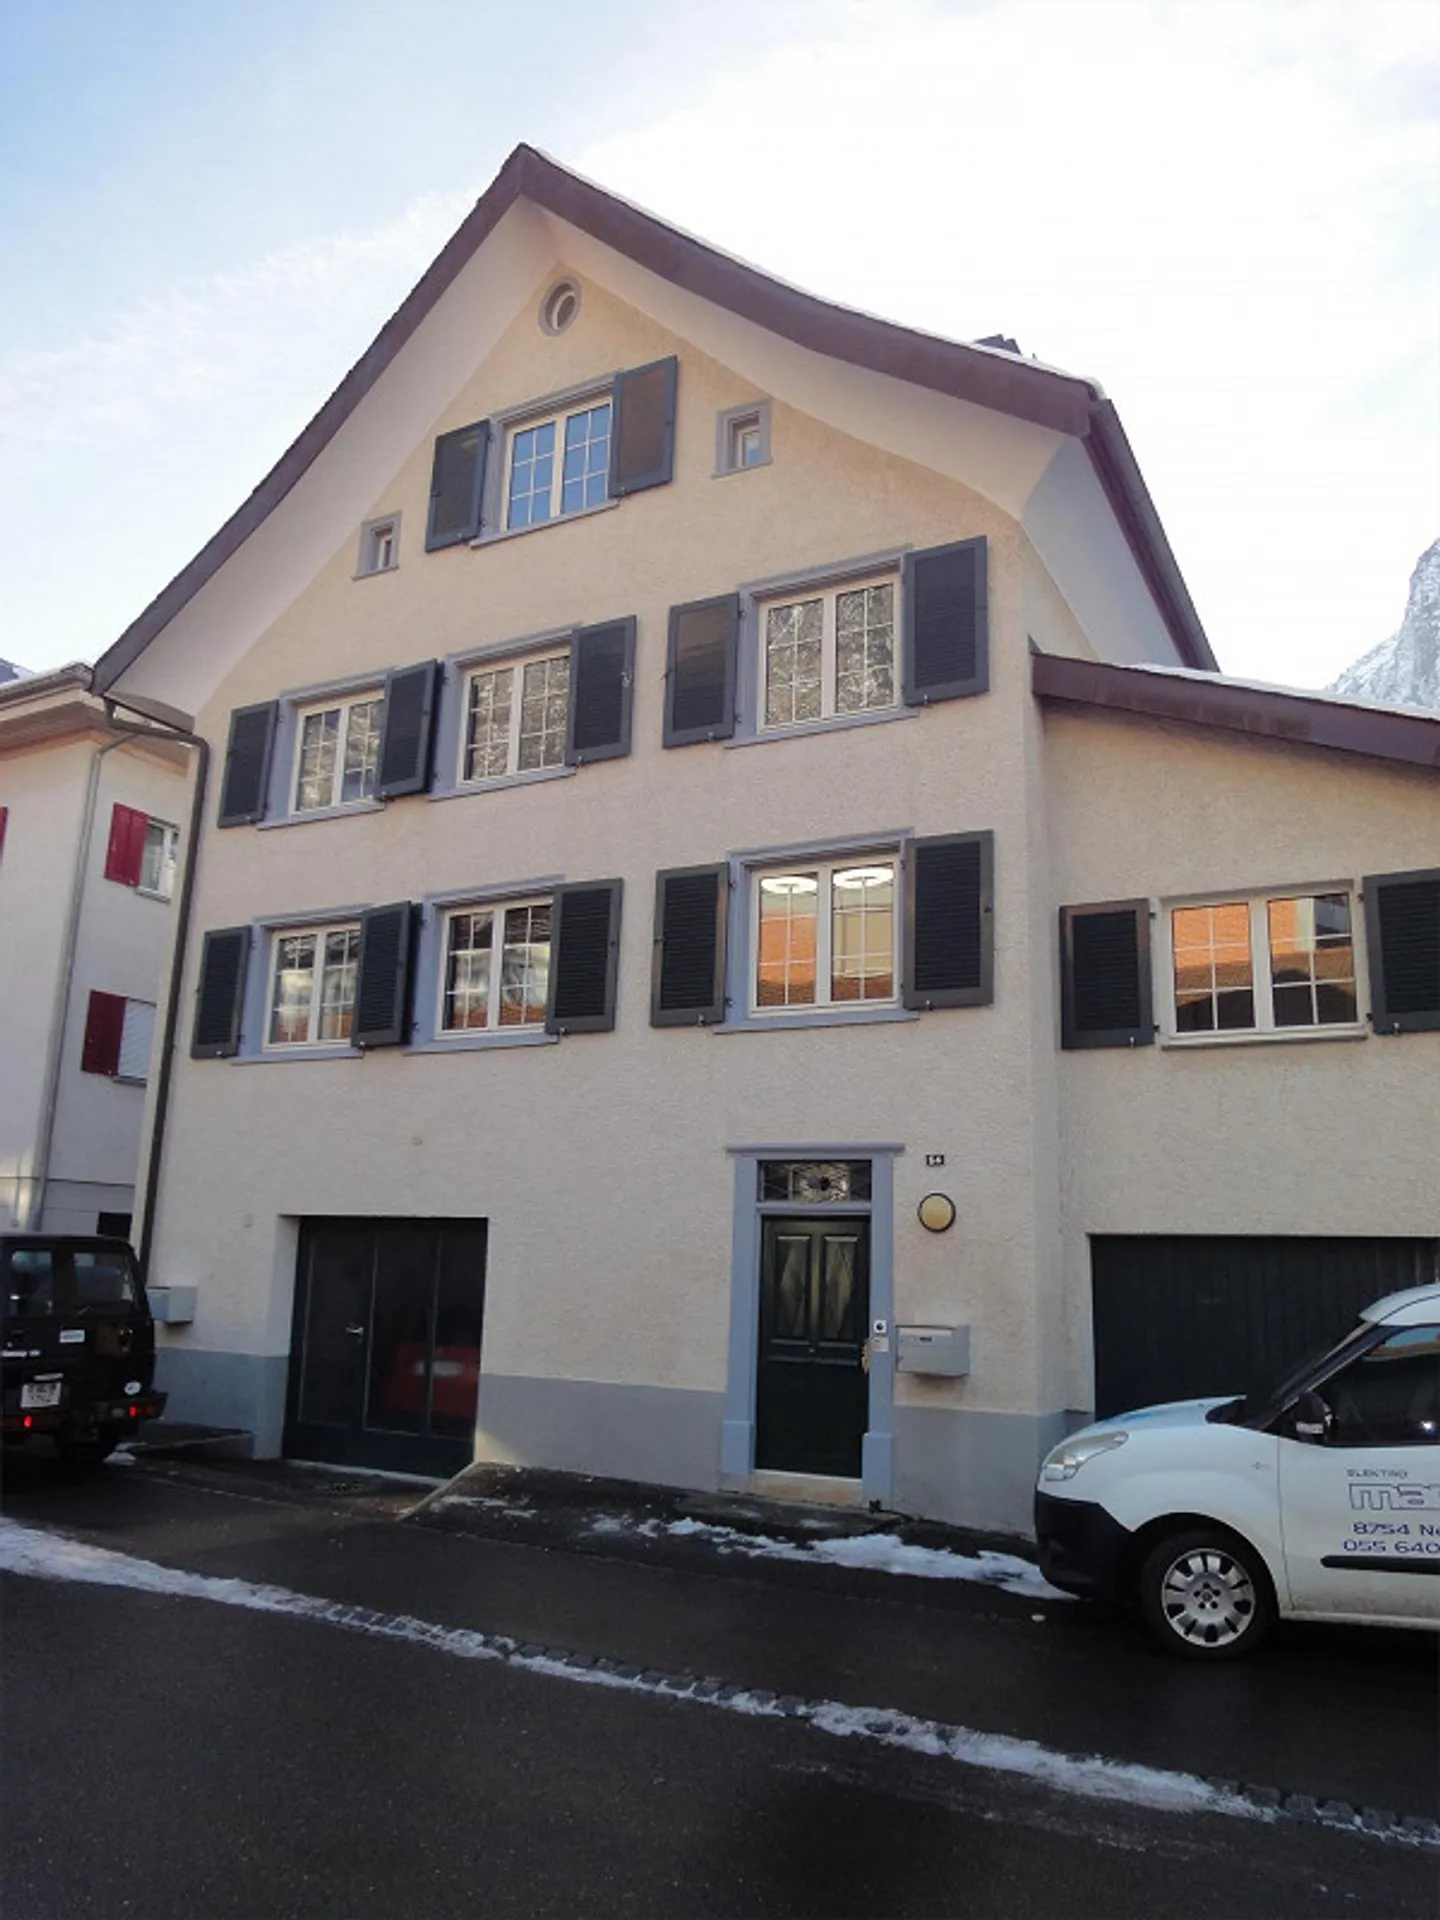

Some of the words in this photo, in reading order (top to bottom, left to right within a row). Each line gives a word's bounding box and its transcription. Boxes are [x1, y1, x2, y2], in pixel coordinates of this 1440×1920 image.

[1347, 1469, 1407, 1477] ELEKTRO
[1354, 1522, 1409, 1534] 8754
[1344, 1540, 1386, 1551] 055
[1395, 1541, 1440, 1553] 640
